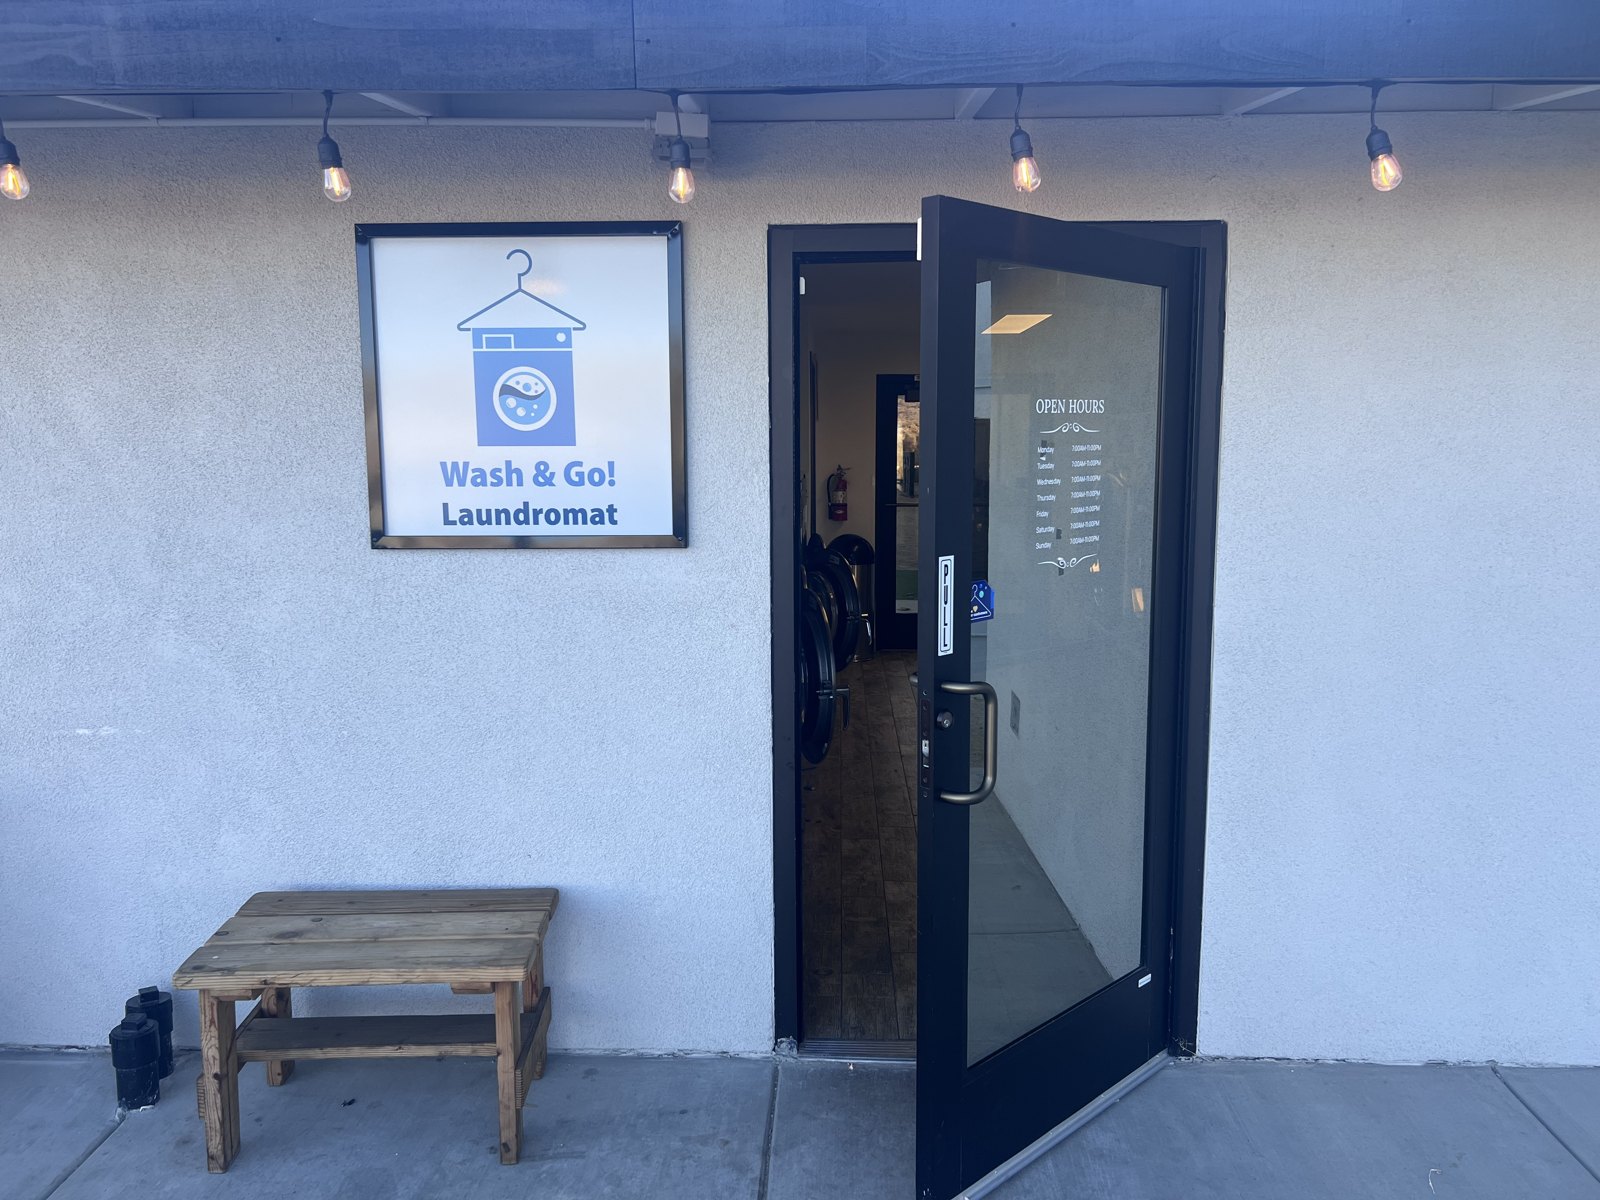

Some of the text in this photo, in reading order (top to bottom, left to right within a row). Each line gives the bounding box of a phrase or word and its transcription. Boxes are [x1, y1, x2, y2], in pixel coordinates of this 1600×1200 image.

[1036, 399, 1105, 414] OPEN HOURS
[1037, 446, 1054, 454] Monday
[1037, 462, 1055, 470] Tuesday
[440, 460, 616, 488] Wash & Go!
[1037, 478, 1061, 486] Wednesday
[1037, 494, 1056, 502] Thursday
[442, 501, 618, 526] Laundromat
[1036, 510, 1049, 518] Friday
[1035, 526, 1055, 534] Saturday
[1035, 542, 1052, 550] Sunday
